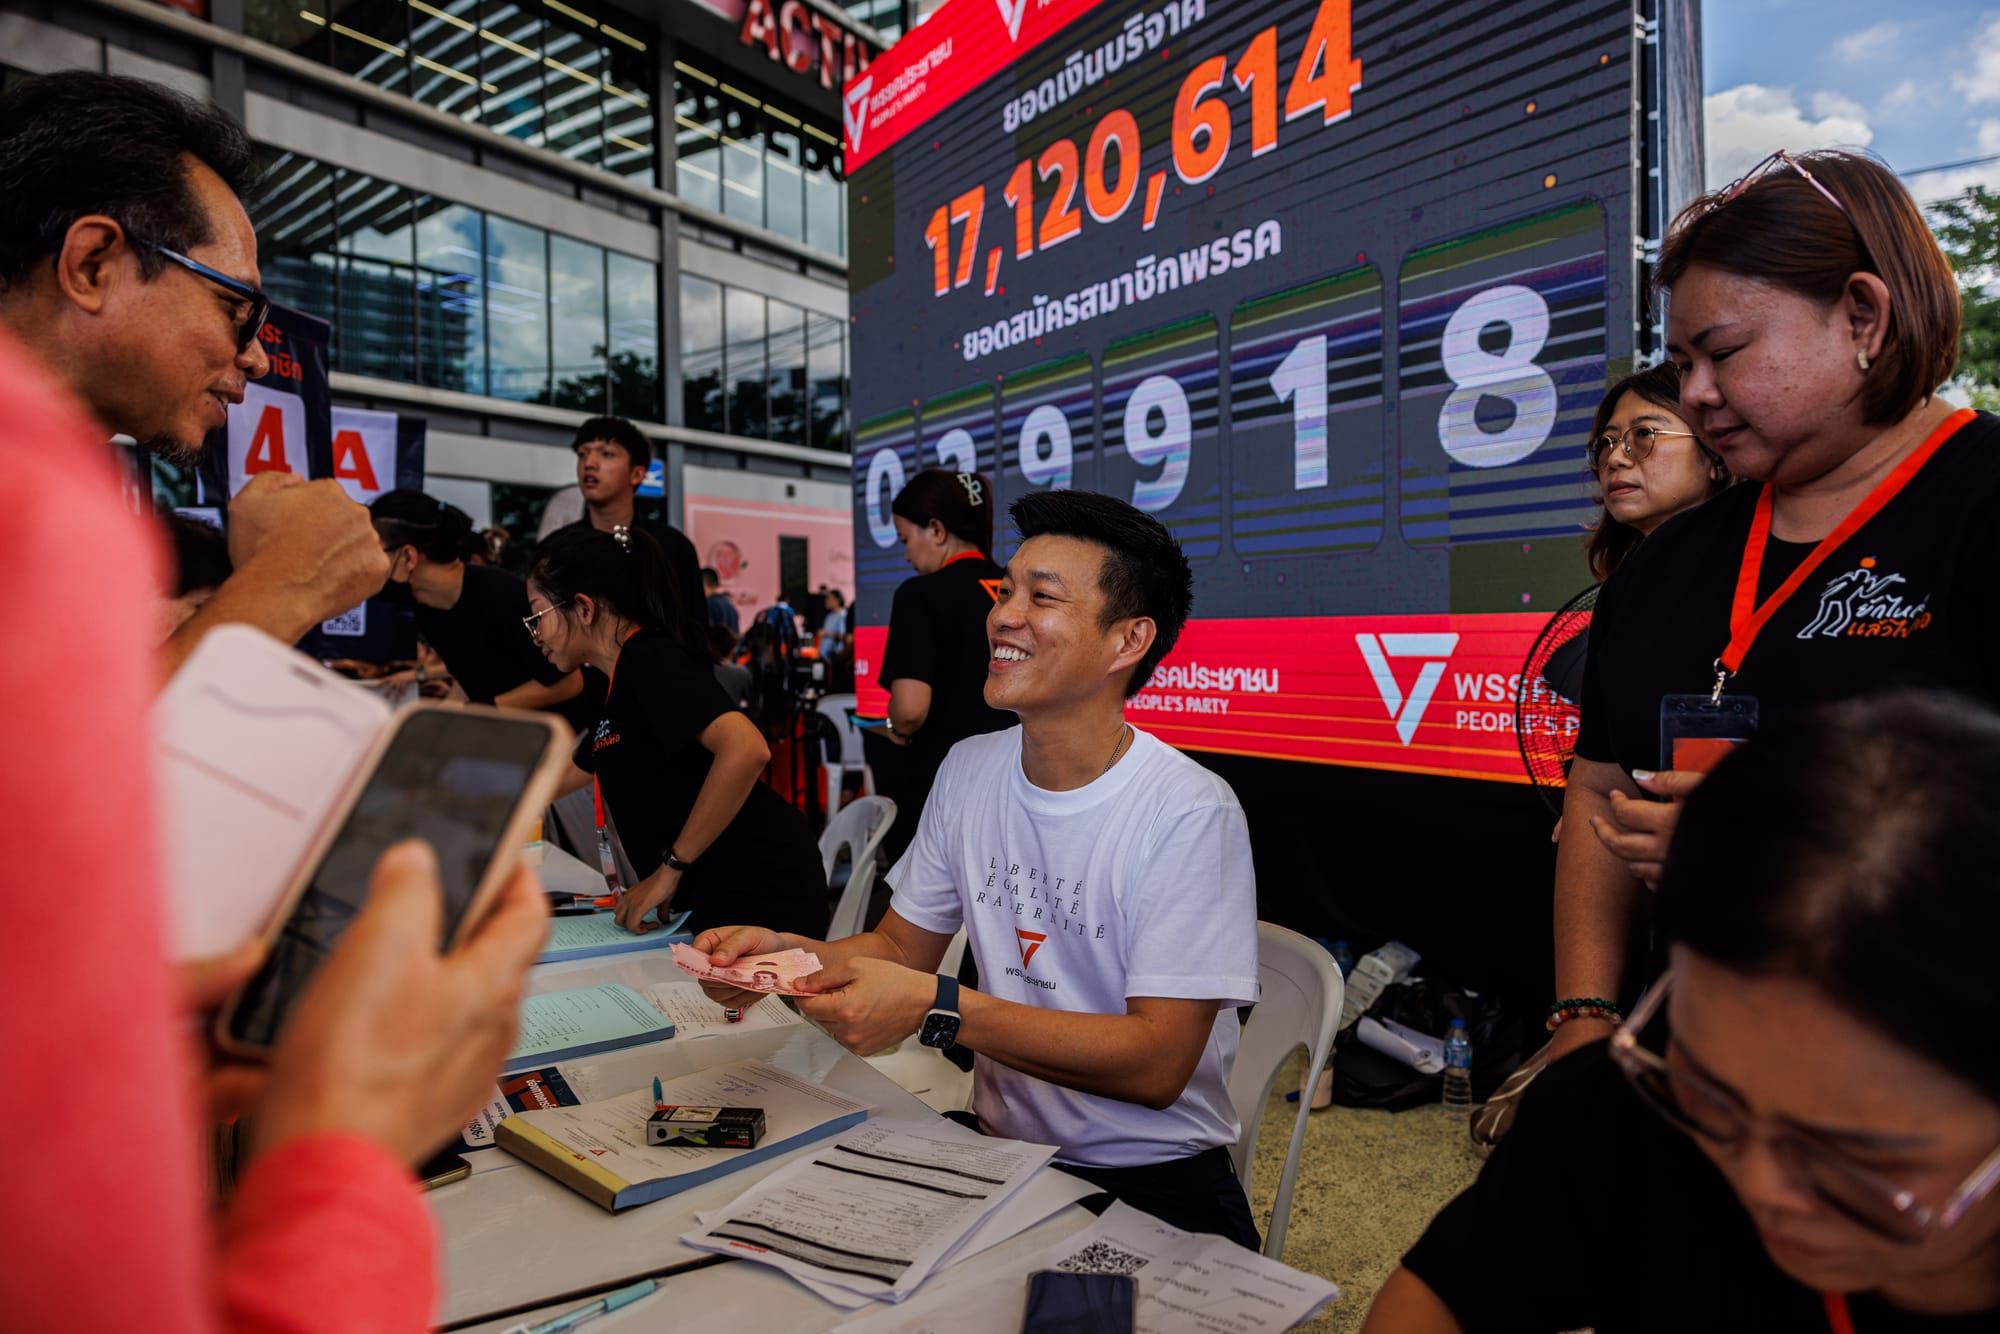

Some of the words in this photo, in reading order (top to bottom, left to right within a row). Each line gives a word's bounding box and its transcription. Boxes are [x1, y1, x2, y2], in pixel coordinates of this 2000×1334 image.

[1002, 0, 1207, 134] ยอดเงินบริจาค
[923, 0, 1363, 298] 17,120,614
[963, 218, 1283, 362] ยอดสมัครสมาชิกพรรค
[1185, 696, 1230, 715] PARTY
[986, 873, 1079, 915] ÉGALITÉ
[990, 857, 1083, 896] LIBERTÉ
